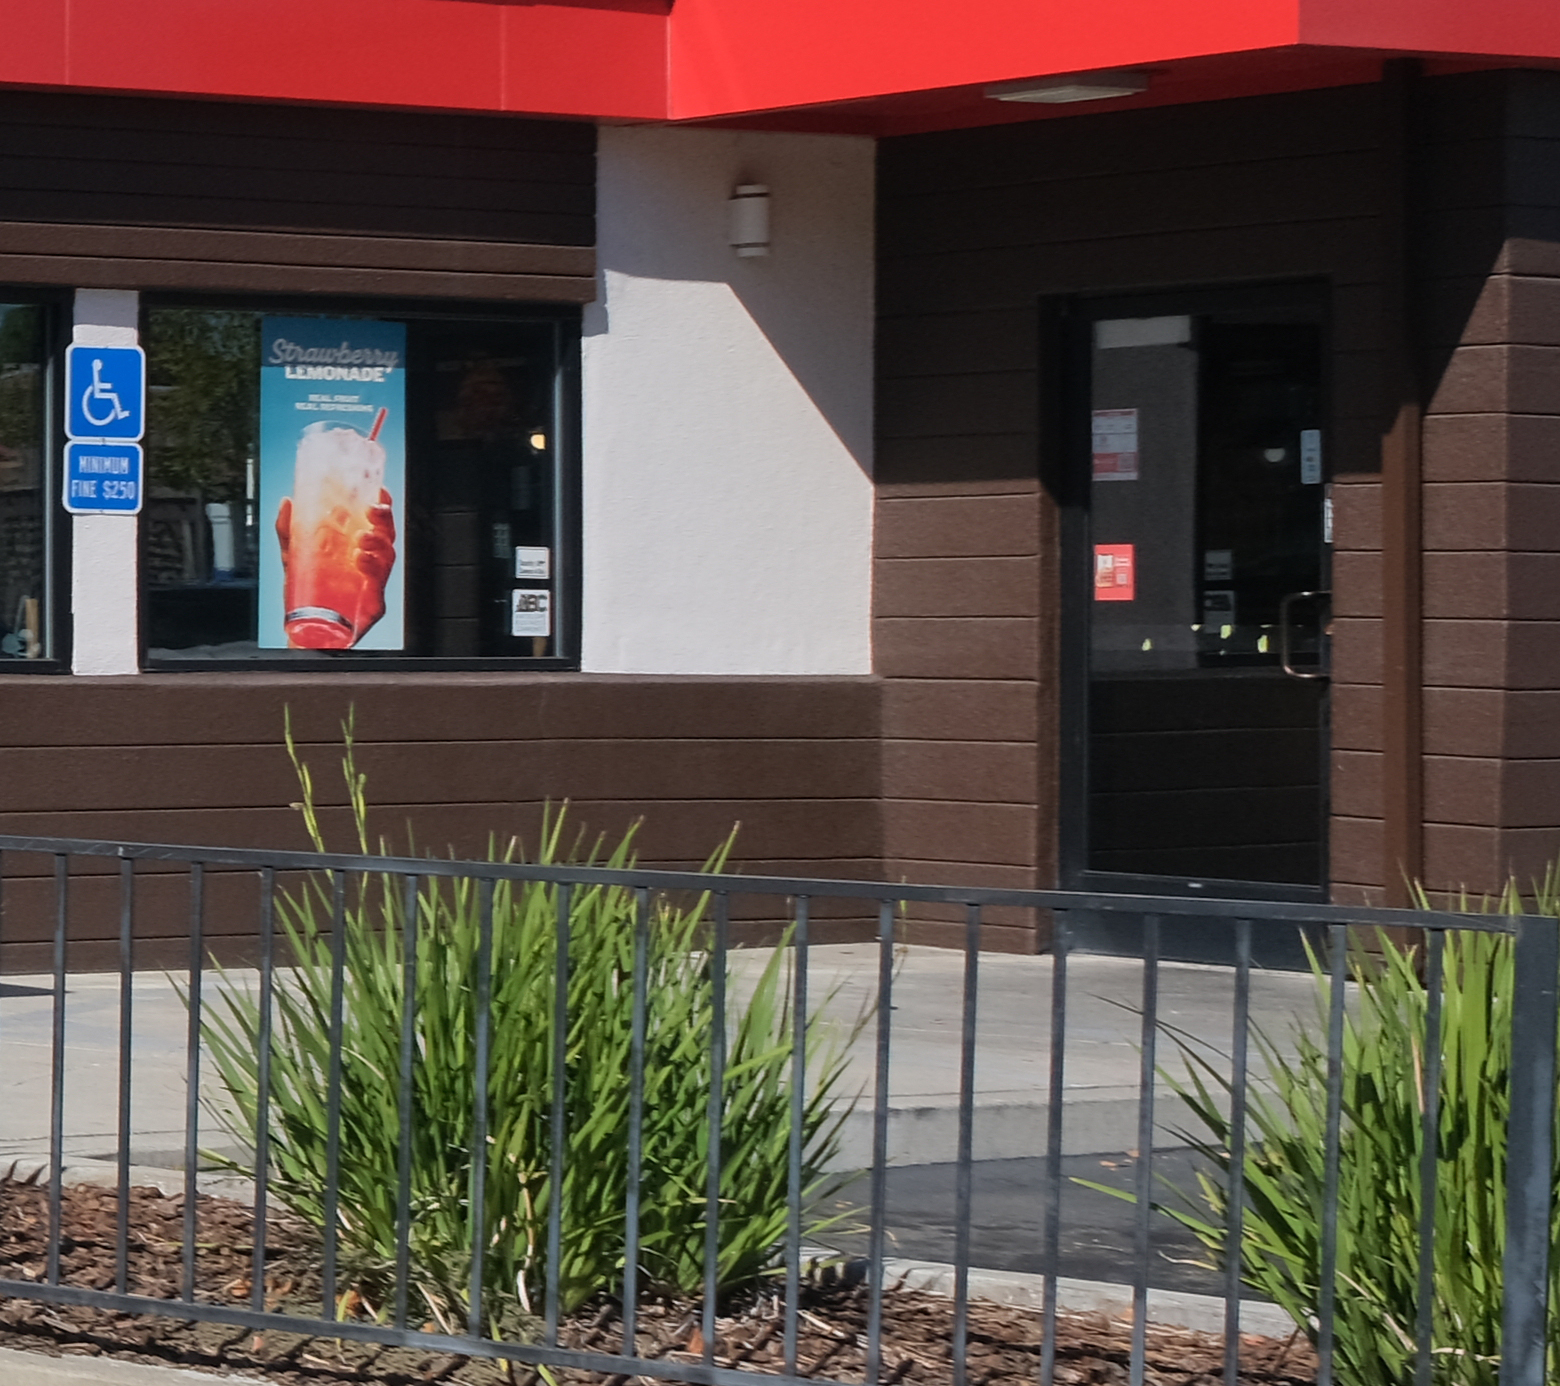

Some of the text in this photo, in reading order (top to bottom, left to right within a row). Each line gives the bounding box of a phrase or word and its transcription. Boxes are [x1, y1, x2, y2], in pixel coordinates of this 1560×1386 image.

[269, 338, 399, 373] Strawberry
[285, 365, 385, 382] LEMONADE
[79, 456, 129, 474] MINIMUM
[71, 479, 136, 501] FINE $250
